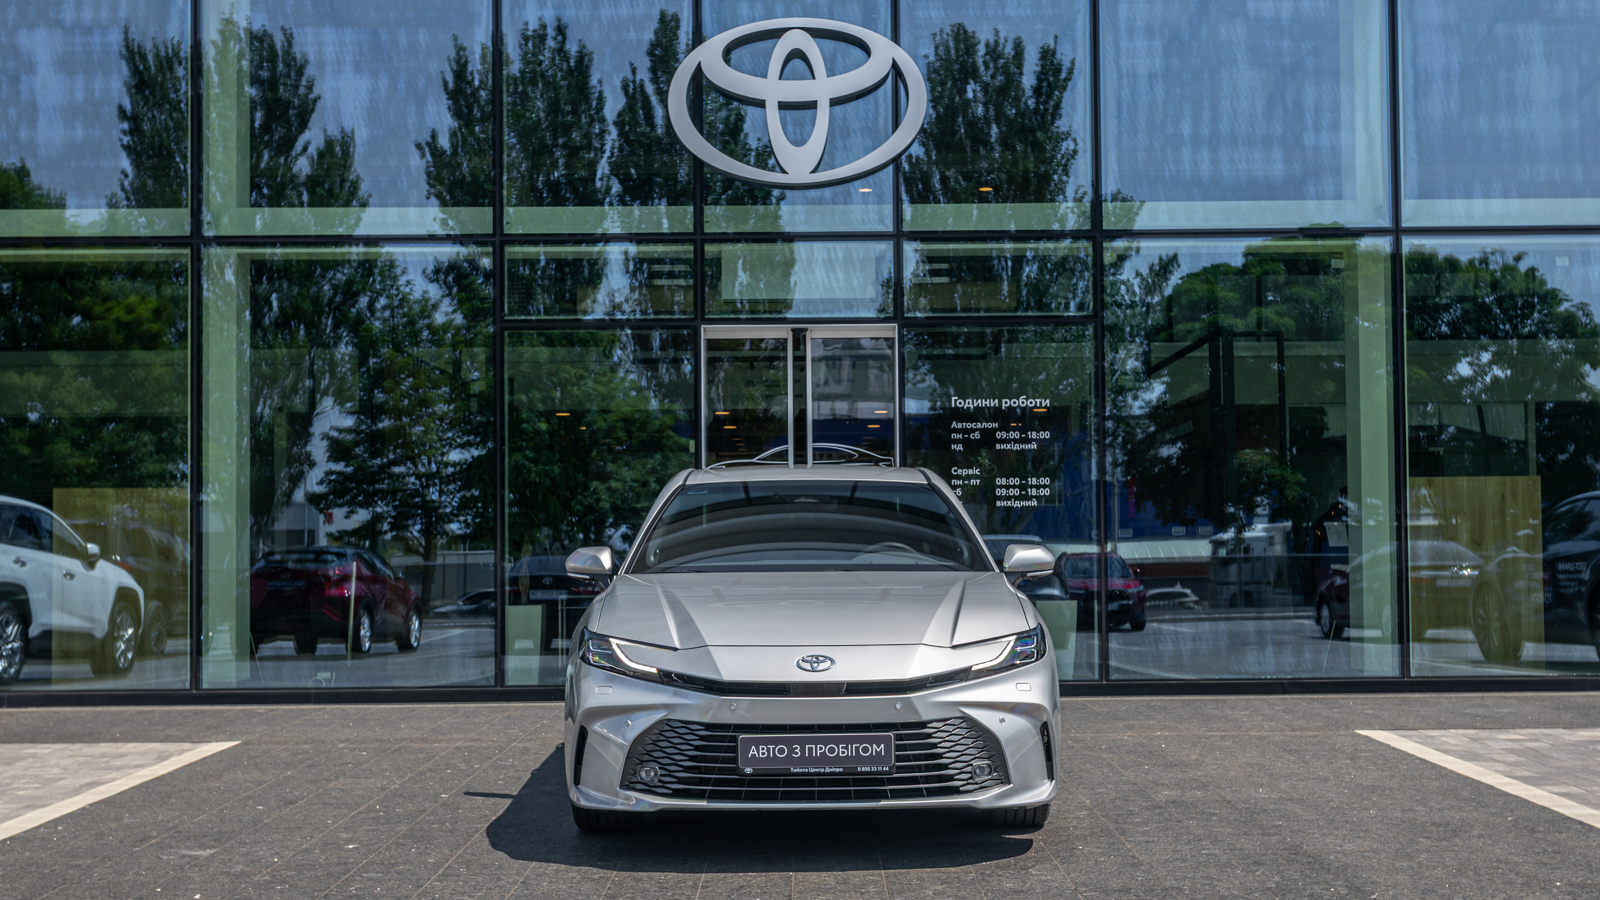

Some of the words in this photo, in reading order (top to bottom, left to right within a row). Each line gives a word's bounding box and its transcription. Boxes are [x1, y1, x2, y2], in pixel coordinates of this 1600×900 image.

[951, 396, 998, 409] Години
[1002, 396, 1050, 410] роботи
[970, 431, 980, 439] сб
[996, 442, 1037, 450] вихідний
[951, 467, 980, 476] Сервіс
[995, 488, 1020, 496] 09:00
[1027, 488, 1051, 496] 18:00
[996, 499, 1037, 507] вихідний
[748, 745, 788, 758] АВТО
[805, 743, 885, 757] ПРОБІГОМ
